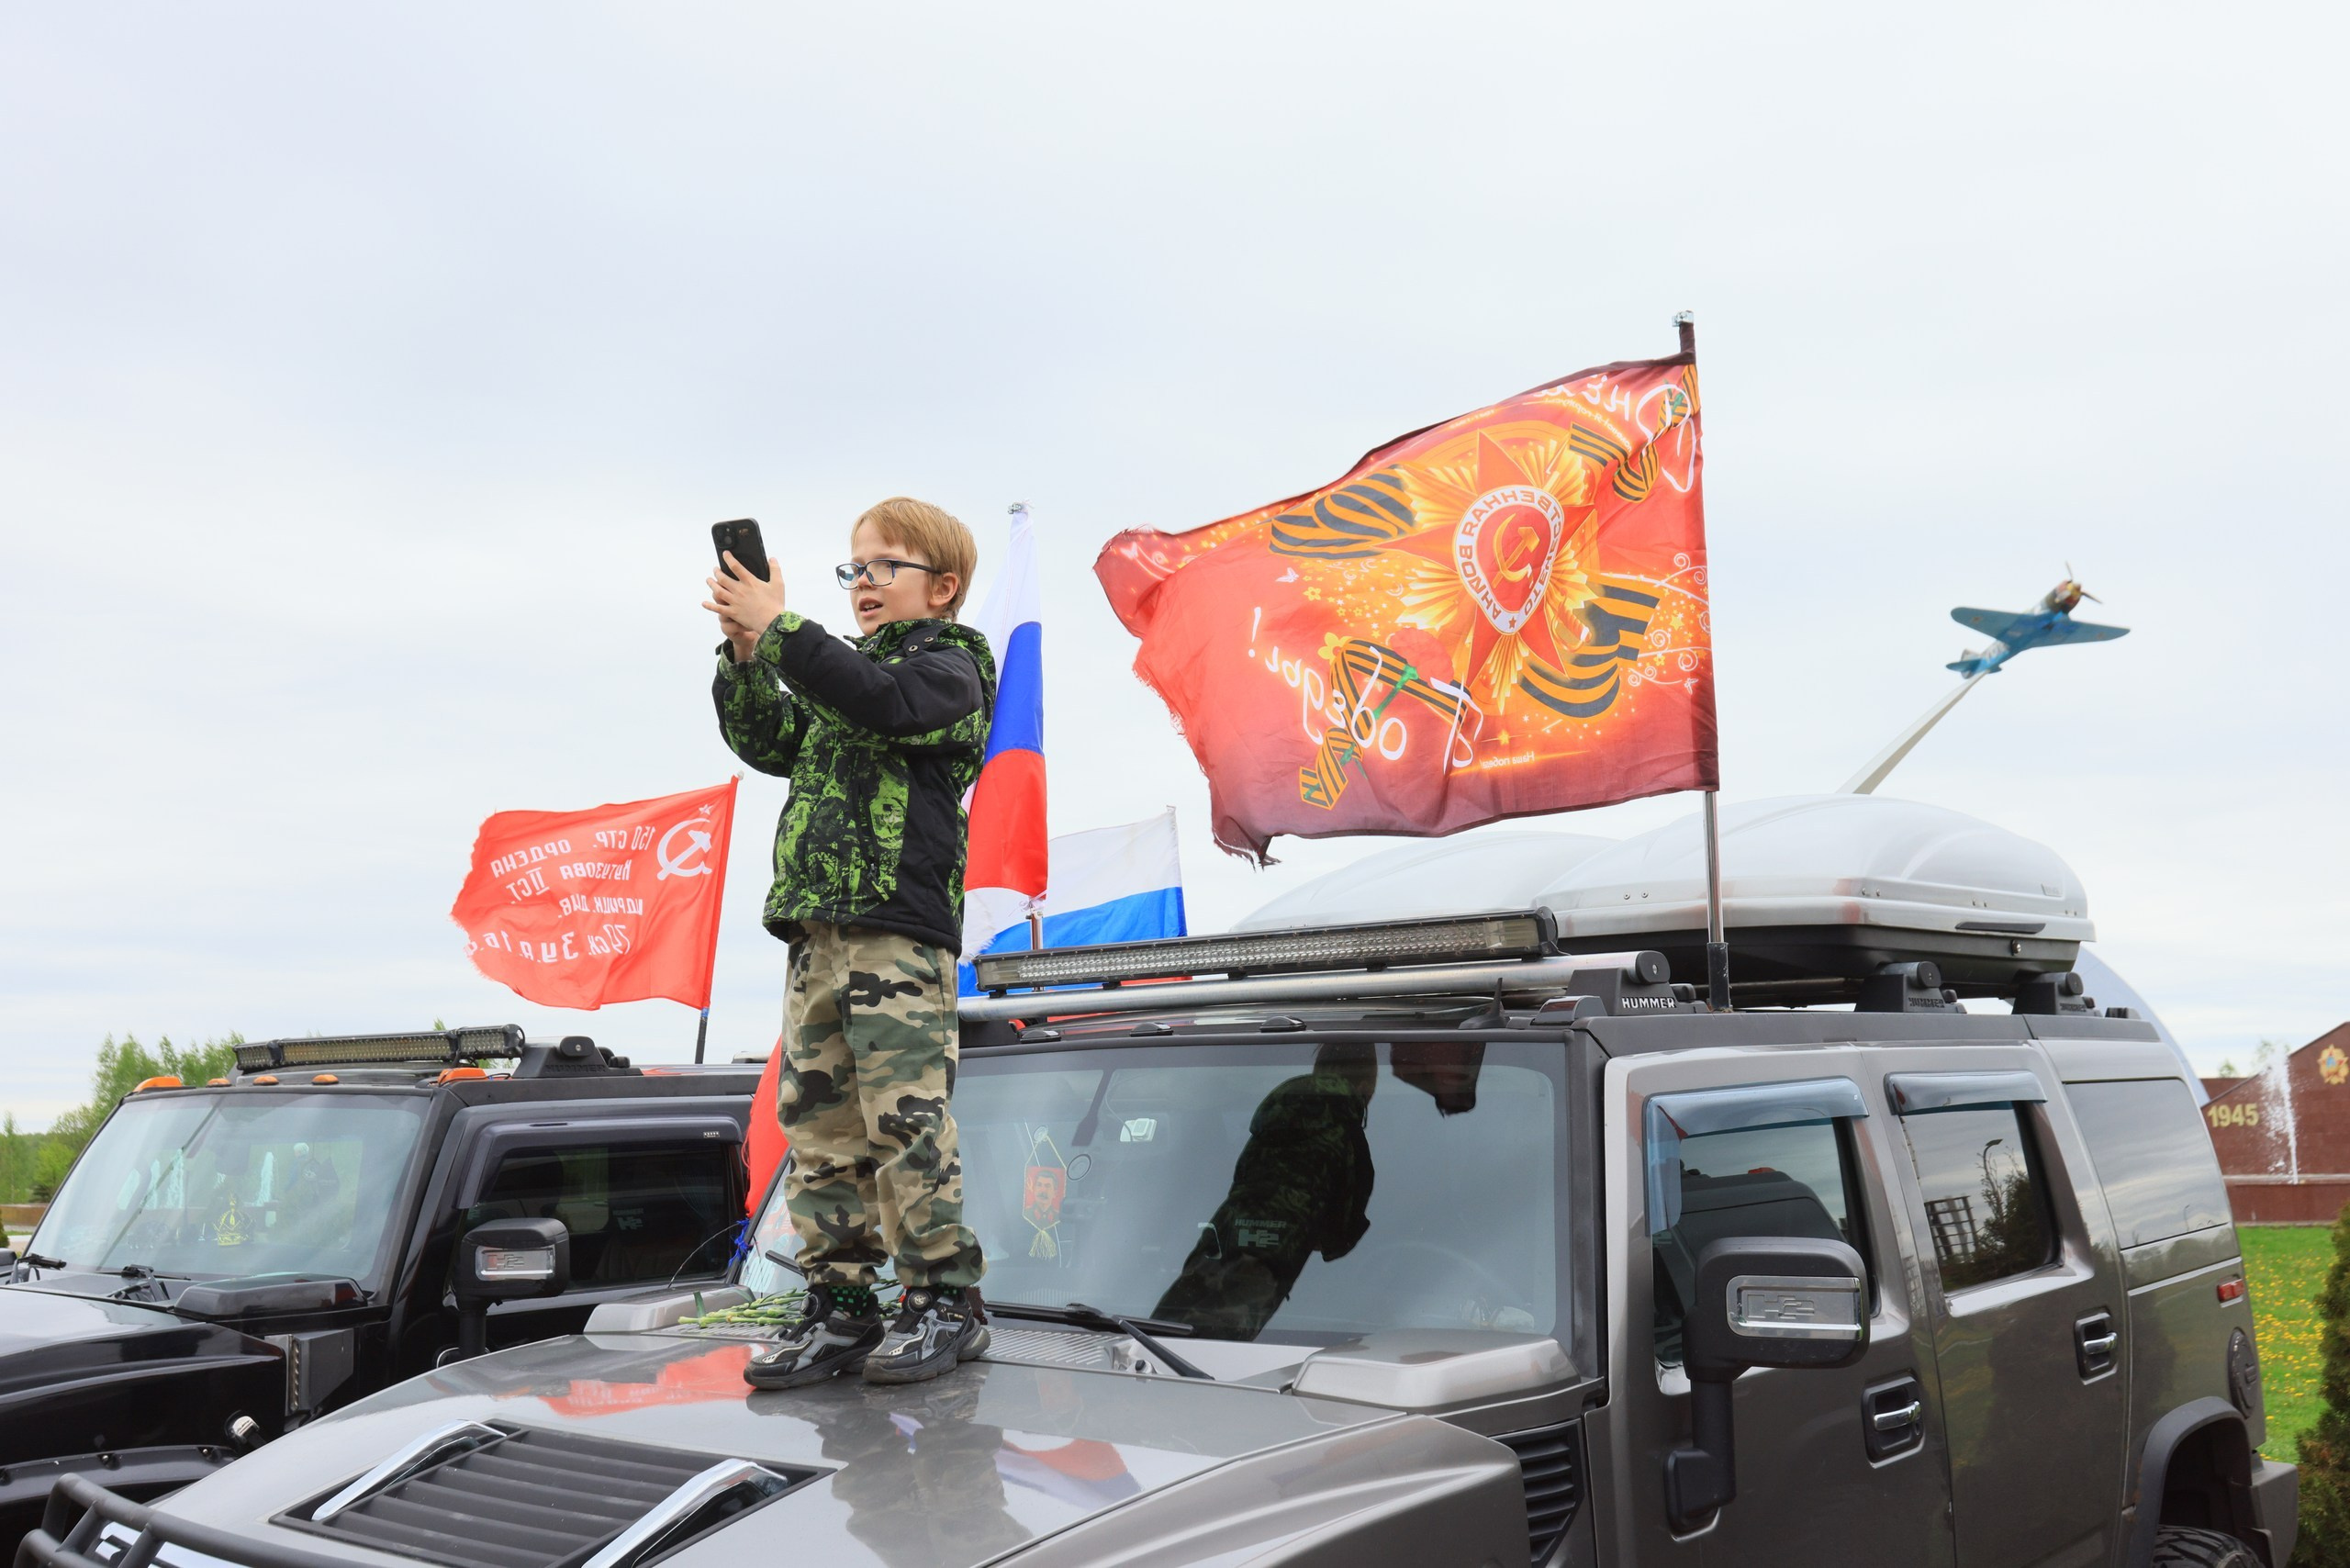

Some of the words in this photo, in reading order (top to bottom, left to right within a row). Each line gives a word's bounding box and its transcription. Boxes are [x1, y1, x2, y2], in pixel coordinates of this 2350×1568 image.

[1621, 997, 1675, 1009] HUMMER
[2208, 1103, 2259, 1127] 1945
[1234, 1218, 1287, 1228] HUMMER
[1238, 1229, 1280, 1248] H2
[487, 1254, 524, 1271] H2
[1747, 1294, 1815, 1319] H2
